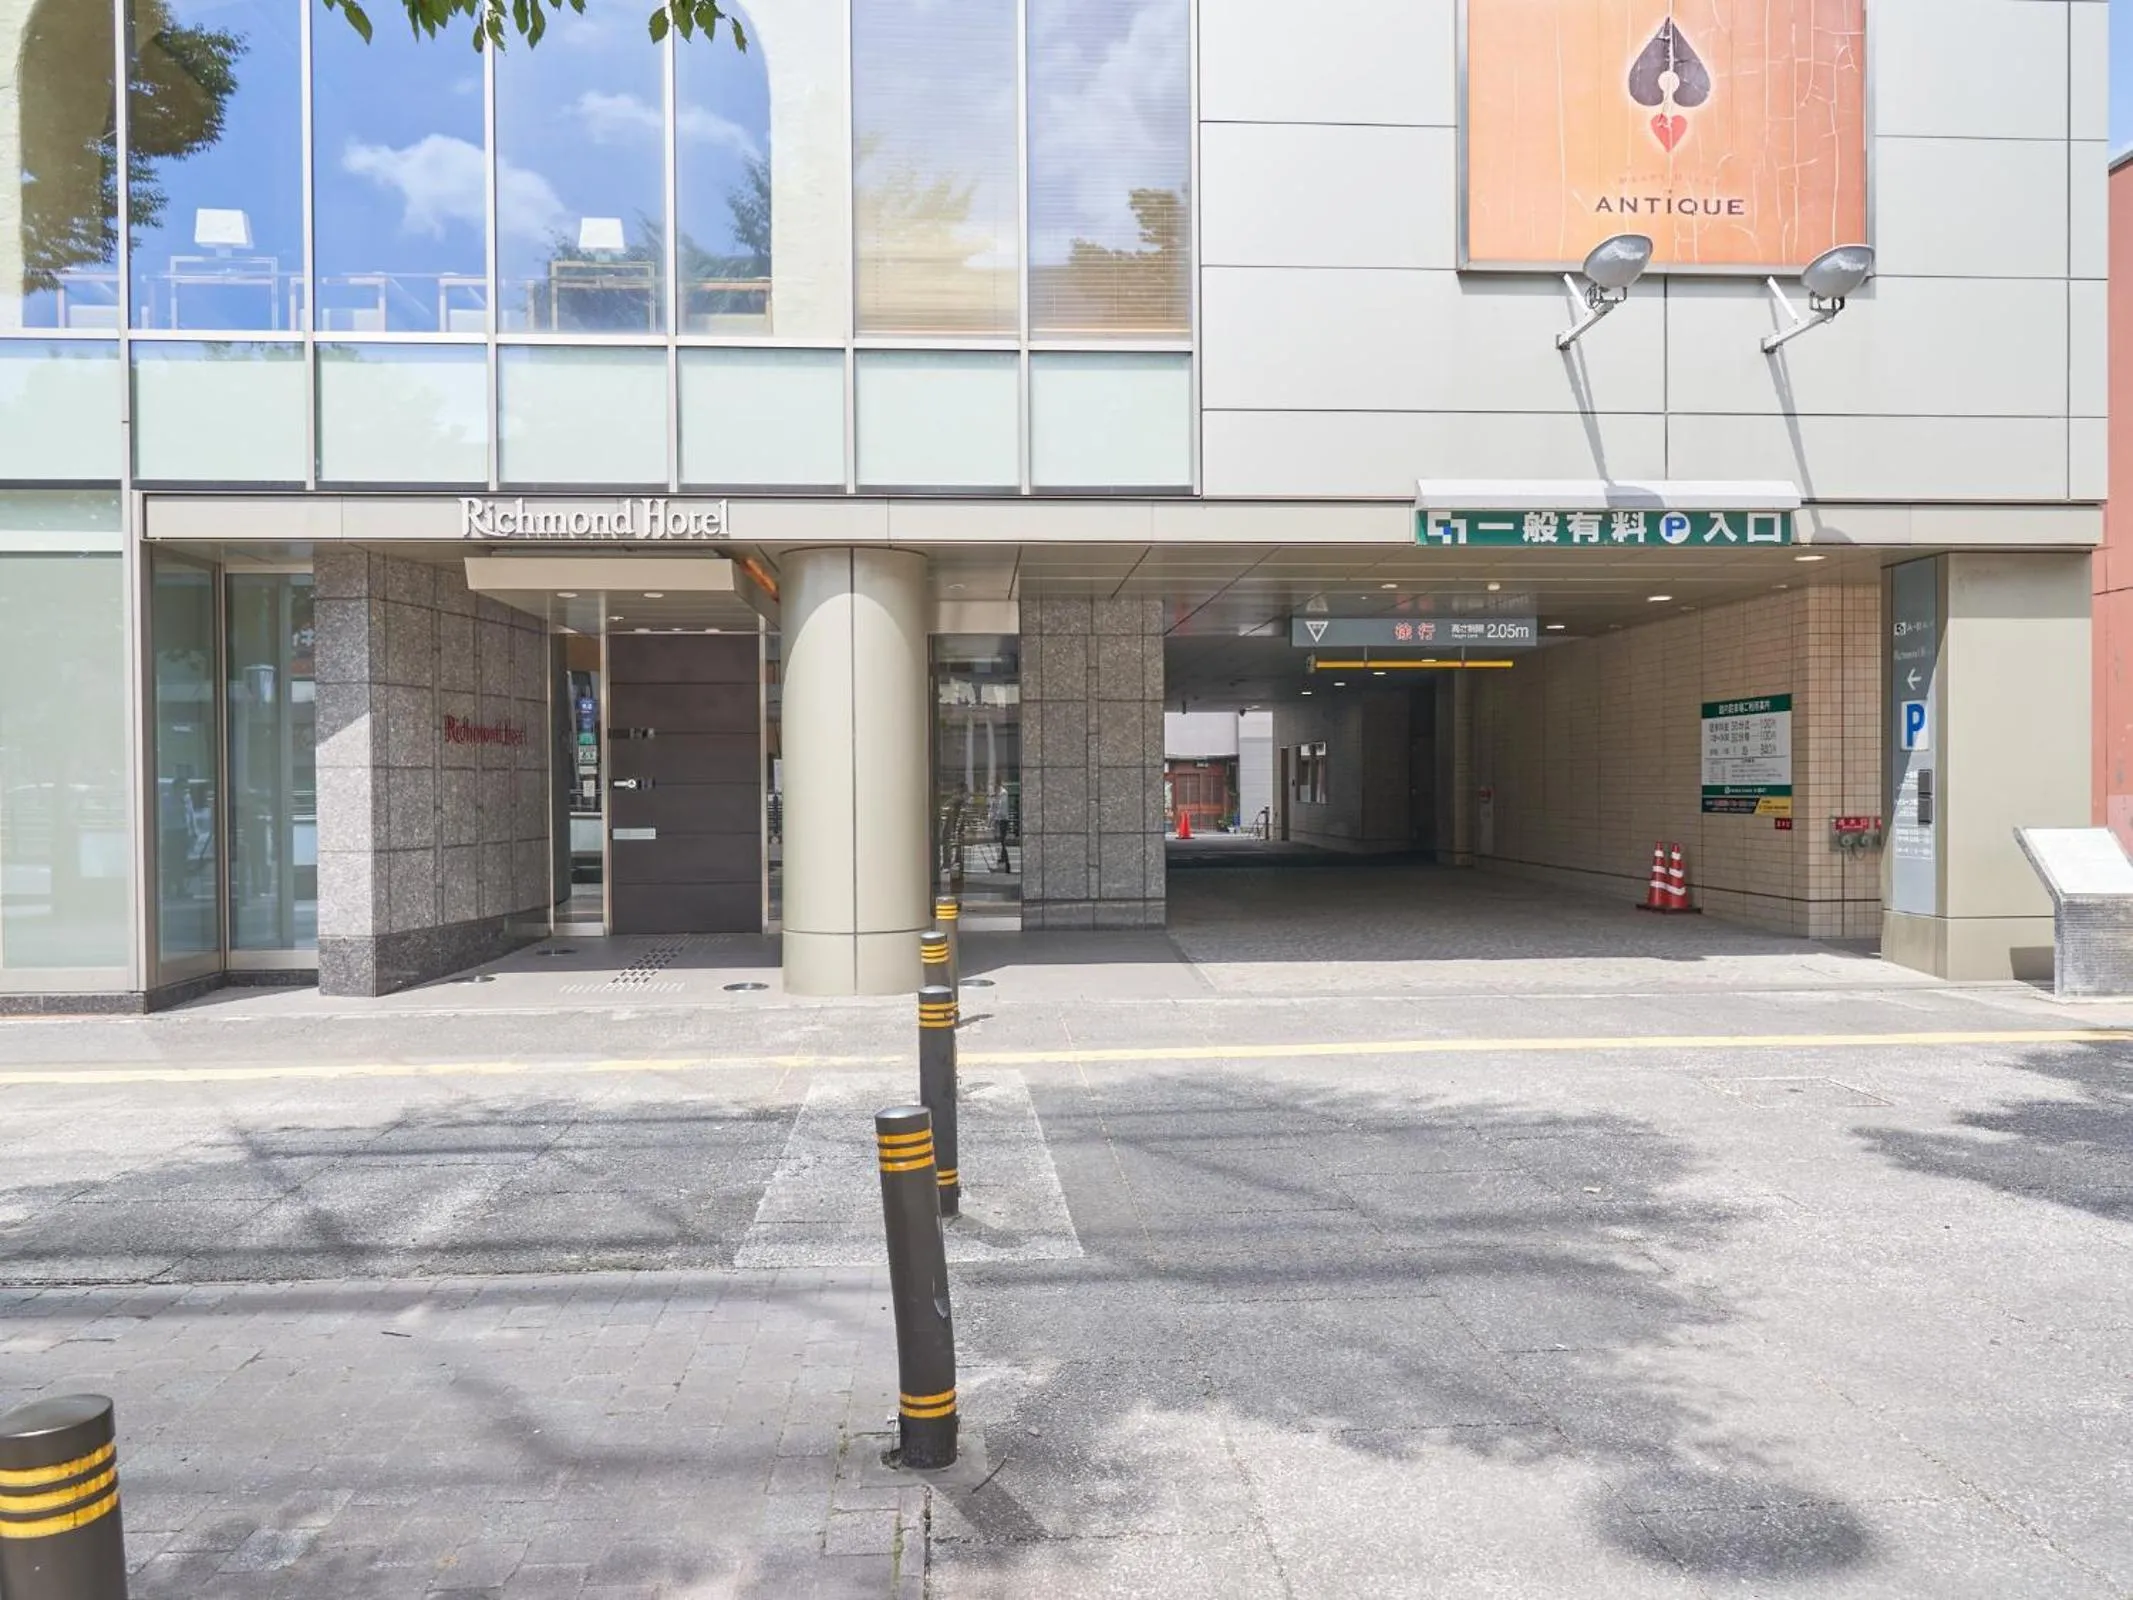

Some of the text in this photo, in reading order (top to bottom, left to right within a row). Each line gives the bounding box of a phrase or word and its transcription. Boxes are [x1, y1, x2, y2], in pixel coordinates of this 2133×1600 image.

[459, 497, 729, 537] Richmond Hotel
[1478, 512, 1647, 543] 一般有料
[1704, 512, 1782, 543] 入口
[1487, 623, 1529, 639] 2.05m
[1907, 704, 1925, 747] P
